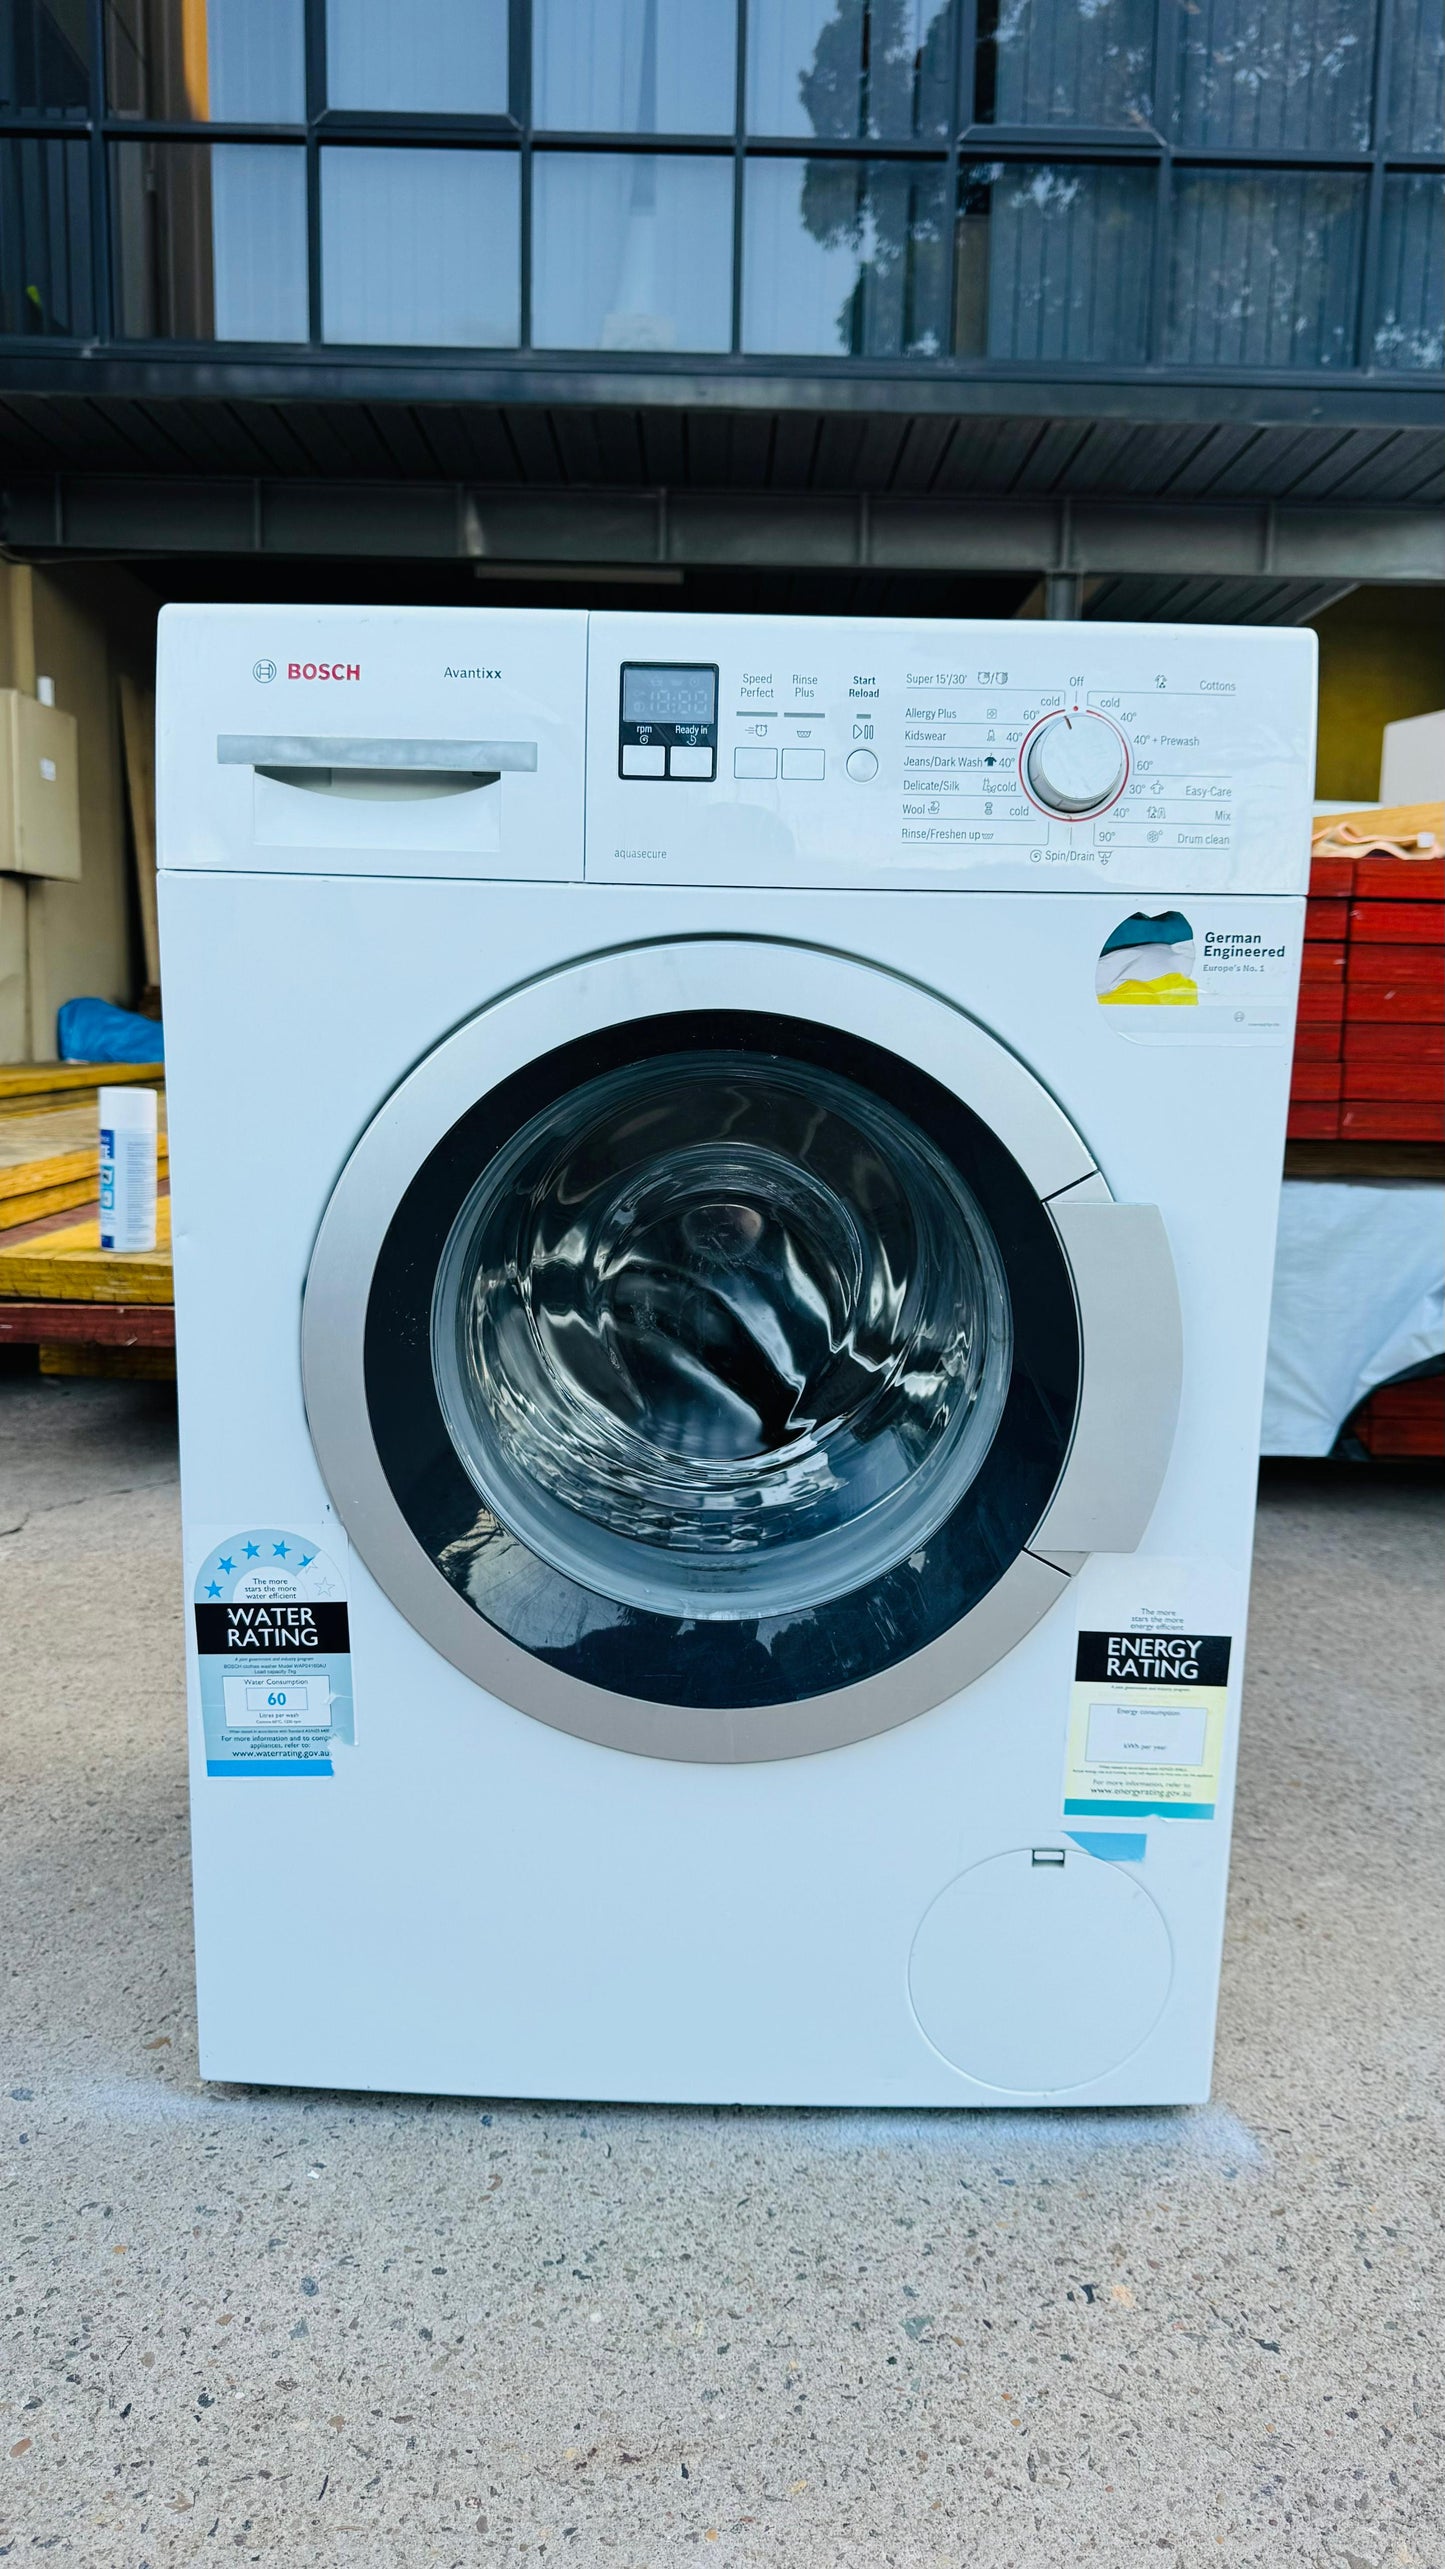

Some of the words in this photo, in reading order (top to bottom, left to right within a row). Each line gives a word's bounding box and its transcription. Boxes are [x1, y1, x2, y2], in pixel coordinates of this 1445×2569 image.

[287, 662, 361, 681] BOSCH
[443, 666, 502, 679] Avantixx
[742, 673, 773, 685] Speed
[792, 674, 818, 685] Rinse
[853, 675, 876, 685] Start
[905, 673, 934, 685] Super
[1069, 676, 1085, 687] Off
[1199, 679, 1237, 691] Cottons
[740, 687, 775, 698] Perfect
[795, 687, 815, 698] Plus
[848, 688, 880, 698] Reload
[1040, 696, 1061, 707] cold
[1099, 697, 1121, 708] cold
[905, 708, 936, 720] Allergy
[937, 708, 957, 719] Plus
[1023, 710, 1040, 721] 60°
[636, 725, 653, 735] rpm
[675, 724, 700, 736] Ready
[904, 730, 946, 741] Kidswear
[1006, 732, 1023, 743] 40°
[1160, 736, 1200, 747] Prewash
[903, 756, 956, 769] Jeans/Dark
[958, 757, 983, 768] Wash
[1136, 760, 1153, 771] 60°
[903, 779, 960, 792] Delicate/Silk
[997, 781, 1017, 792] cold
[1129, 784, 1146, 795] 30°
[902, 804, 926, 815] Wool
[1009, 806, 1030, 817] cold
[1214, 810, 1232, 821] Mix
[901, 828, 967, 840] Rinse/Freshen
[968, 831, 981, 841] up
[1099, 831, 1116, 842] 90°
[1177, 833, 1204, 844] Drum
[1205, 834, 1230, 845] clean
[614, 849, 668, 859] aquasecure
[1045, 850, 1095, 862] Spin/Drain
[1205, 931, 1262, 944] German
[1203, 945, 1286, 960] Engineered
[1202, 964, 1242, 973] Europe's
[1243, 965, 1258, 973] No.
[268, 1592, 297, 1600] efficient
[226, 1607, 317, 1627] WATER
[1141, 1608, 1154, 1616] The
[227, 1627, 320, 1648] RATING
[1107, 1637, 1203, 1660] ENERGY
[1106, 1658, 1200, 1679] RATING
[266, 1679, 309, 1688] Consumption
[267, 1692, 287, 1706] 60
[232, 1750, 330, 1759] www.waterrating.gov.au
